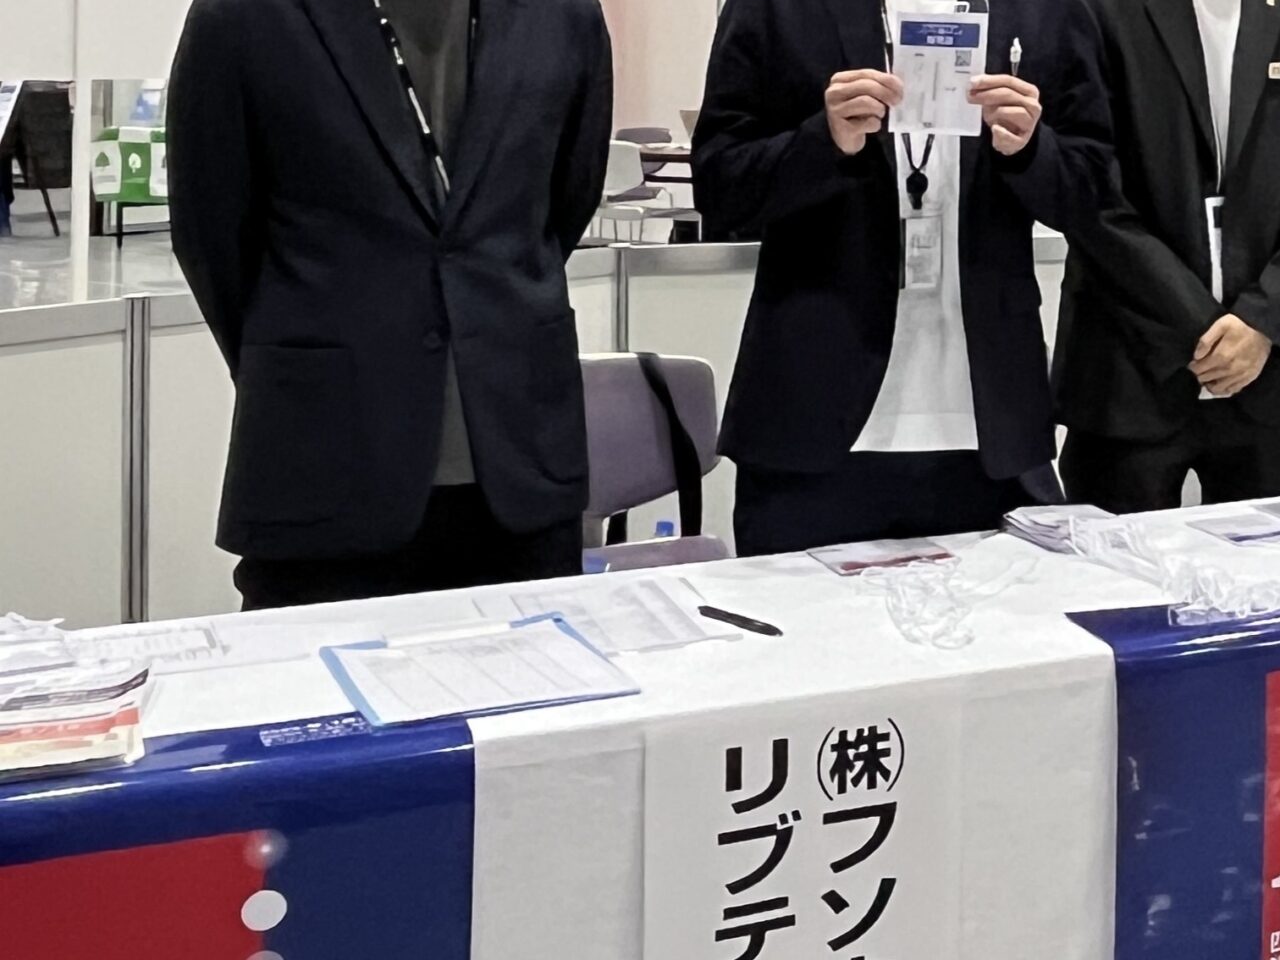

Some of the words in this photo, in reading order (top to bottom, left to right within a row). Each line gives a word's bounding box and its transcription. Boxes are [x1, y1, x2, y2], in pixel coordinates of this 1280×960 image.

[715, 738, 802, 960] リブテ
[817, 717, 905, 960] (株)フソ
